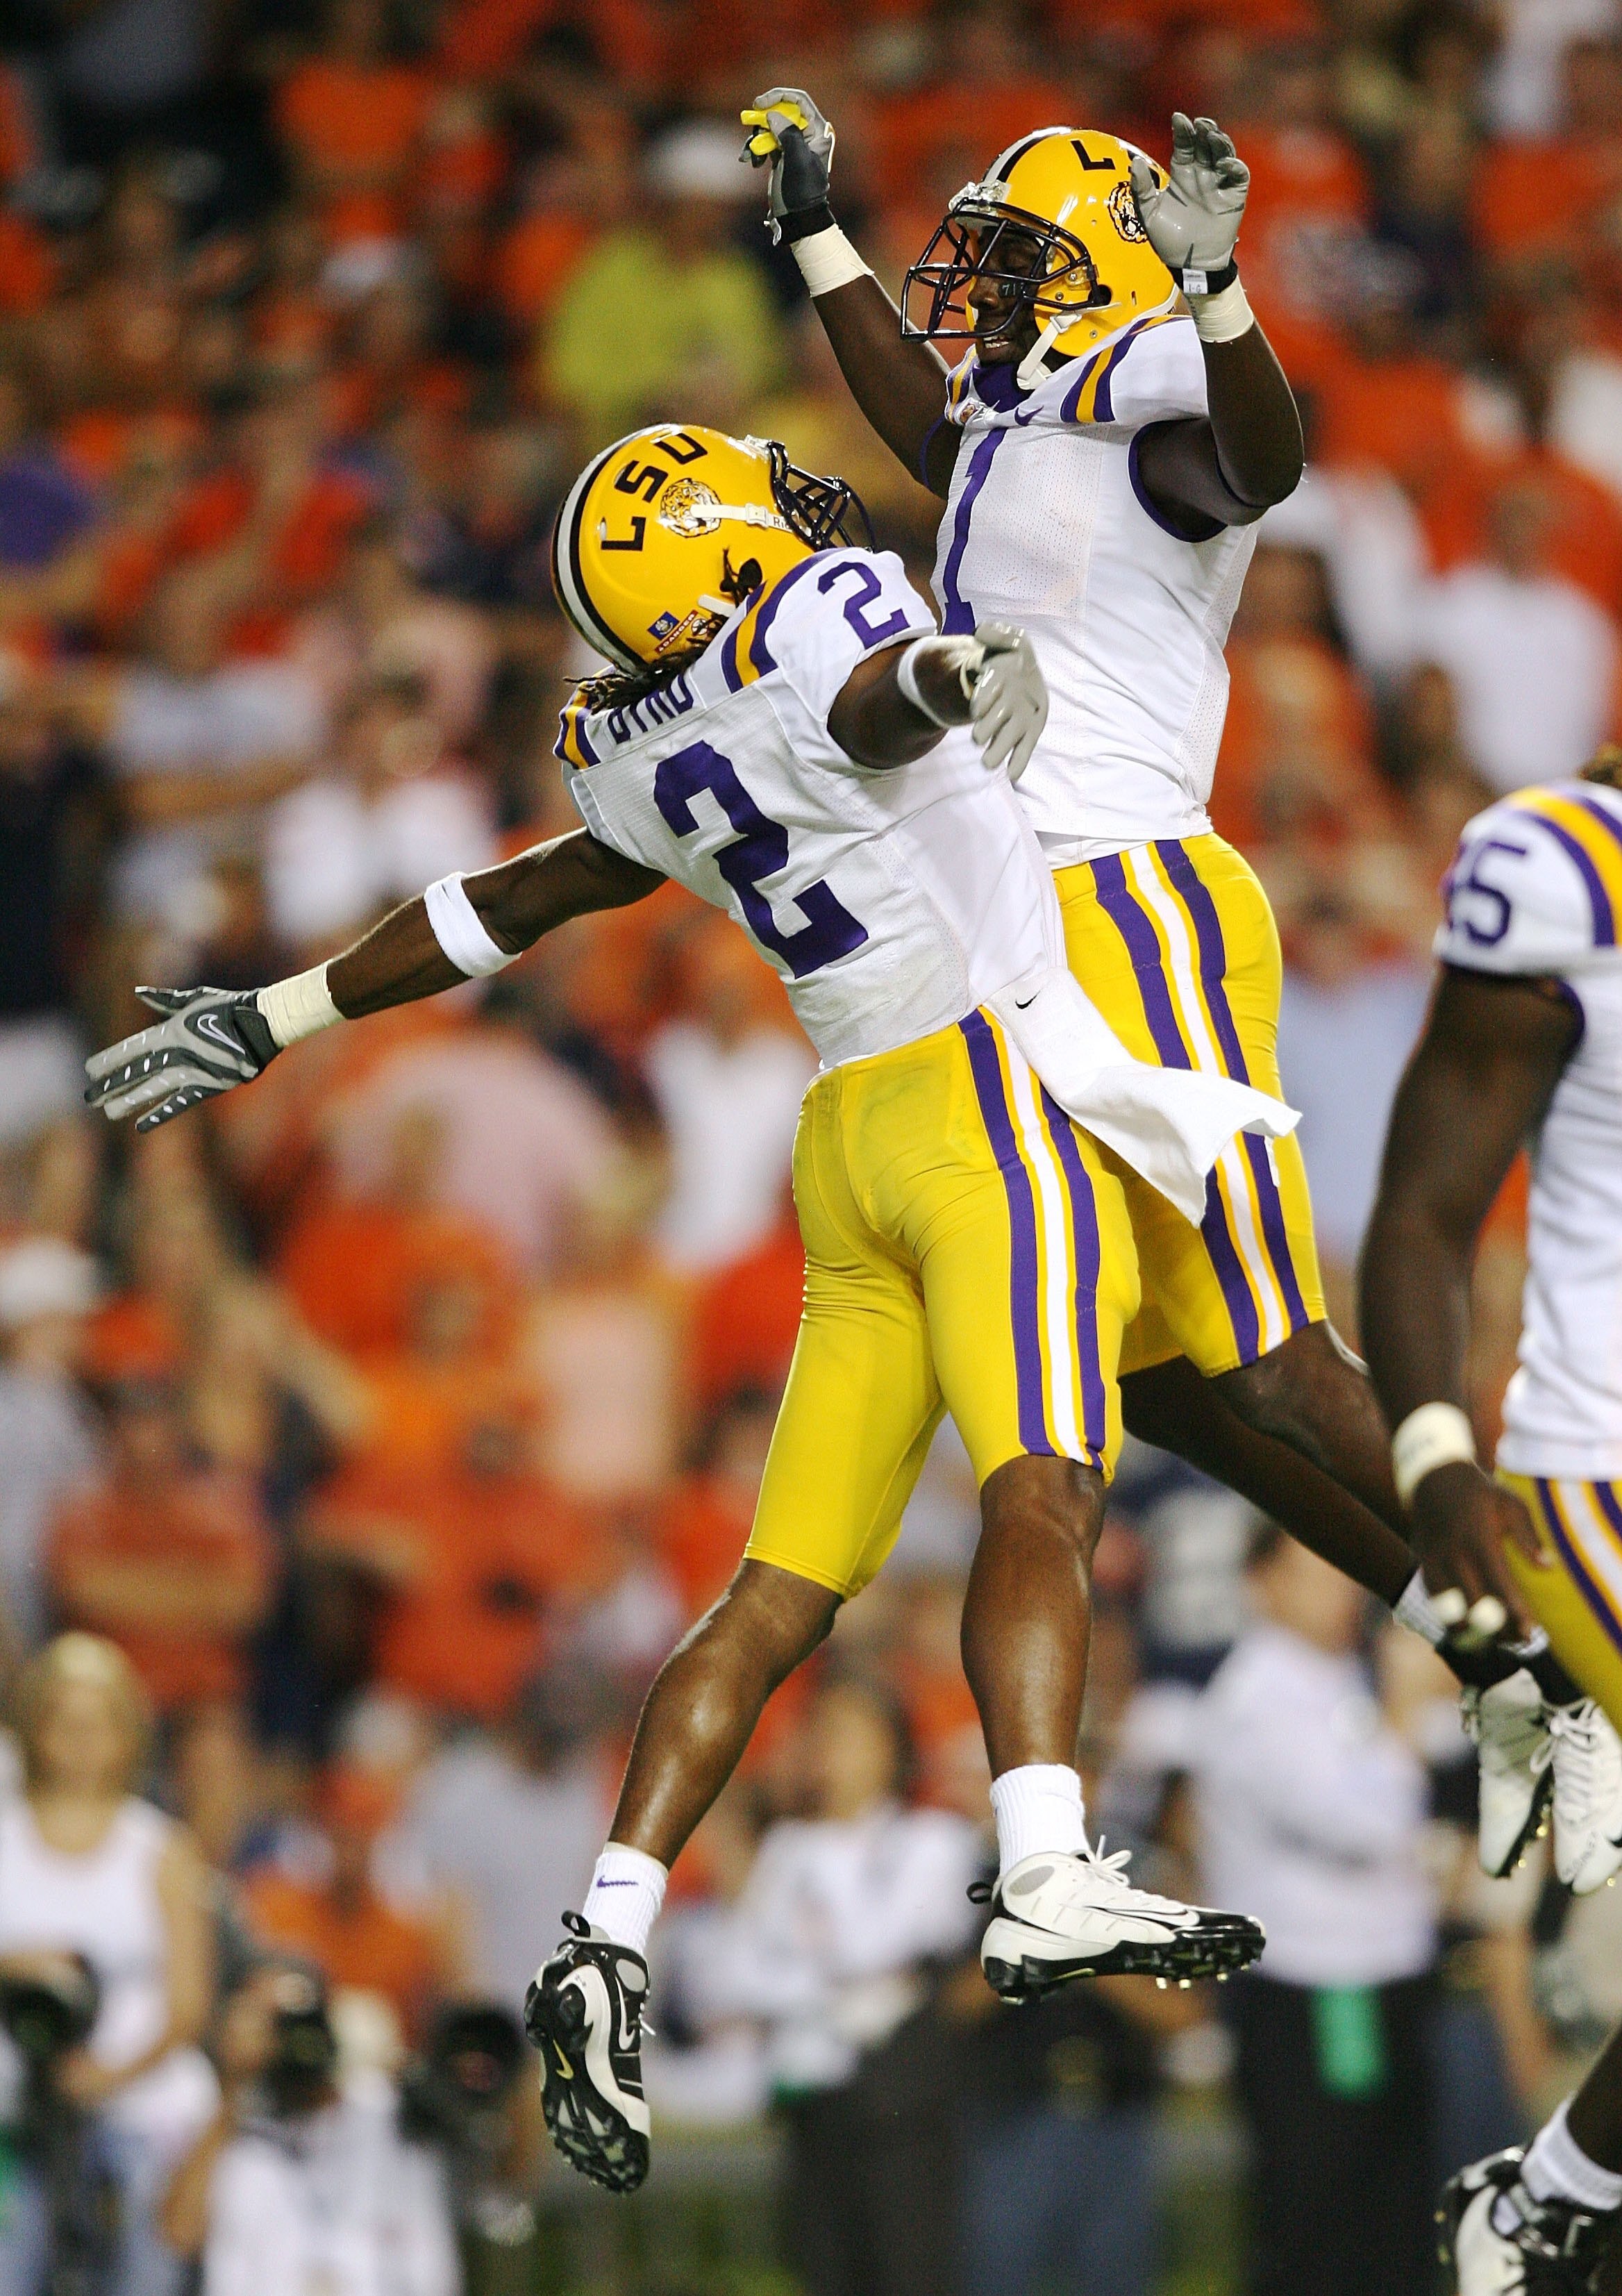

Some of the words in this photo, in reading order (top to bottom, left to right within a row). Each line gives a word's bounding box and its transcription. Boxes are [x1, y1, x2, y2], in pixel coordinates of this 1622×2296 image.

[601, 432, 708, 551] LSU
[817, 561, 910, 650] 2
[654, 740, 869, 980] 2
